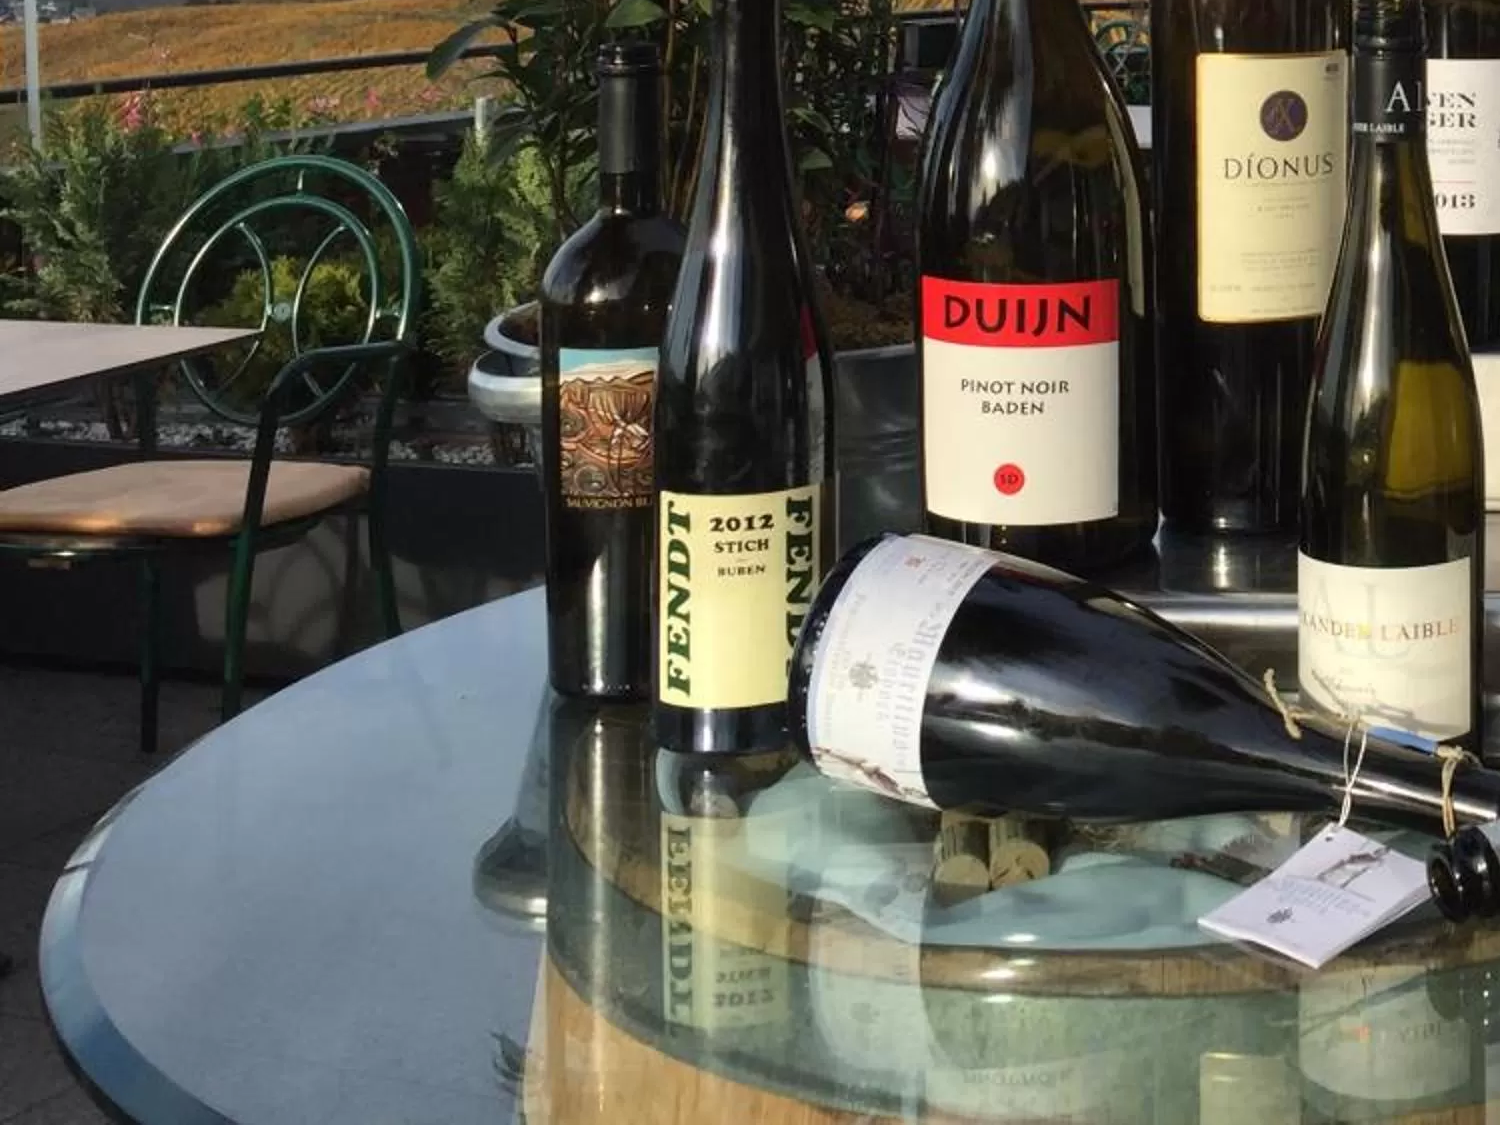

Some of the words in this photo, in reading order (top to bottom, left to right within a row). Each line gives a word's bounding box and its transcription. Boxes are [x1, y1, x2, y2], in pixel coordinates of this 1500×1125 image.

[943, 294, 1092, 337] DUIJN
[960, 378, 1016, 395] PINOT
[1020, 379, 1070, 395] NOIR
[981, 400, 1045, 416] BADEN
[709, 513, 775, 532] 2012
[714, 537, 769, 553] STICH
[785, 495, 813, 679] FEND
[667, 500, 691, 698] FENDT
